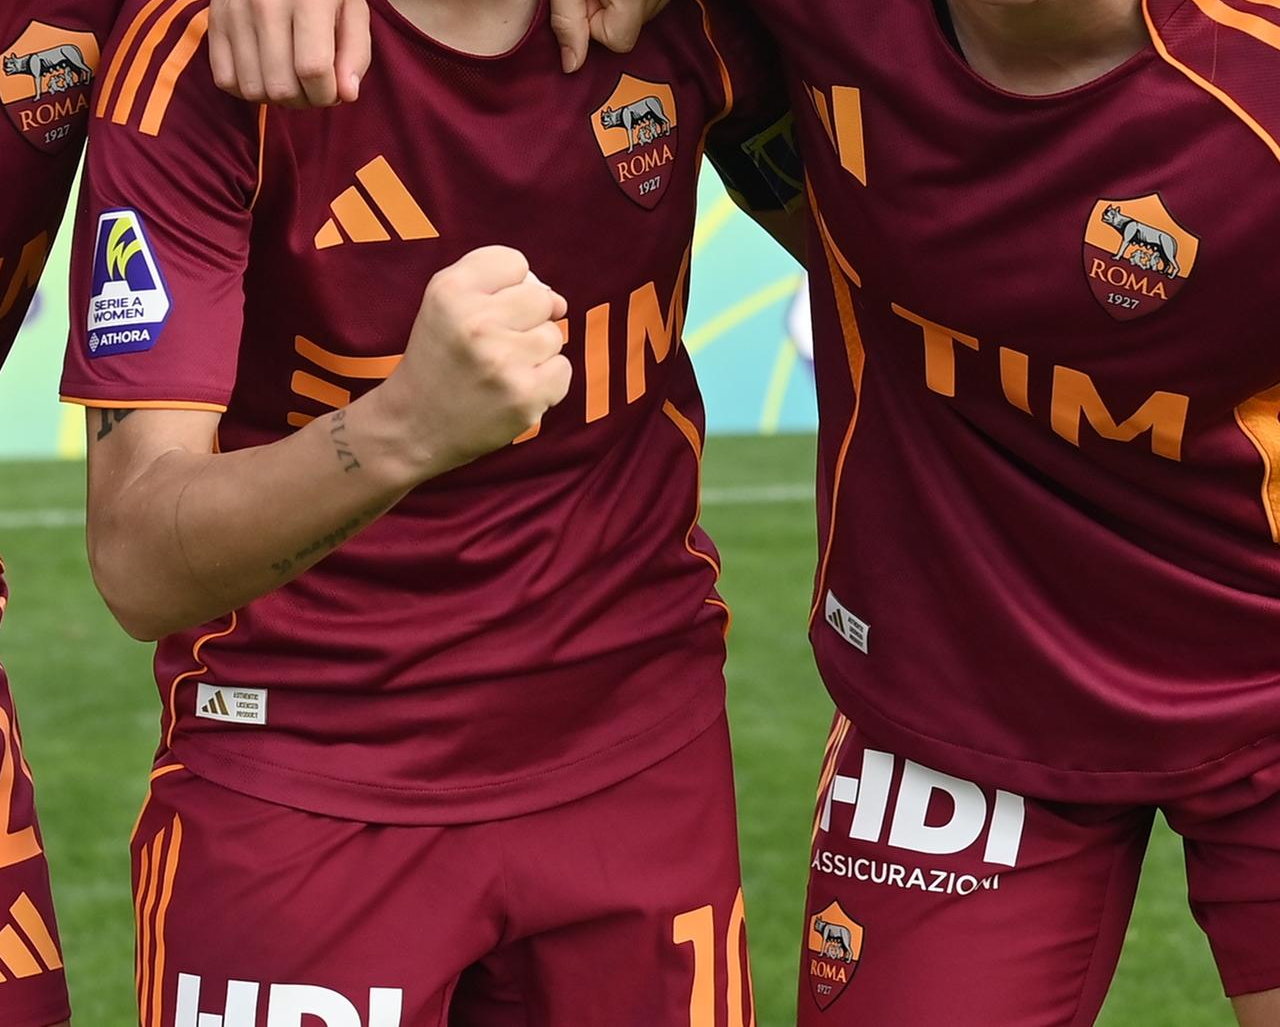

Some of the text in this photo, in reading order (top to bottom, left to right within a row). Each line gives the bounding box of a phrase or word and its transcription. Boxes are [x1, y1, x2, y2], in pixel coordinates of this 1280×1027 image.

[19, 94, 88, 131] ROMA
[44, 124, 71, 143] 1927
[617, 144, 674, 183] ROMA
[639, 176, 661, 195] 1927
[1089, 258, 1168, 300] ROMA
[94, 296, 142, 311] SERIE A
[1107, 293, 1140, 309] 1927
[93, 308, 144, 323] WOMEN
[100, 329, 150, 346] ATHORA
[513, 246, 690, 444] IM
[891, 302, 1190, 462] TIM
[819, 748, 1025, 868] HDI
[810, 959, 847, 983] ROMA
